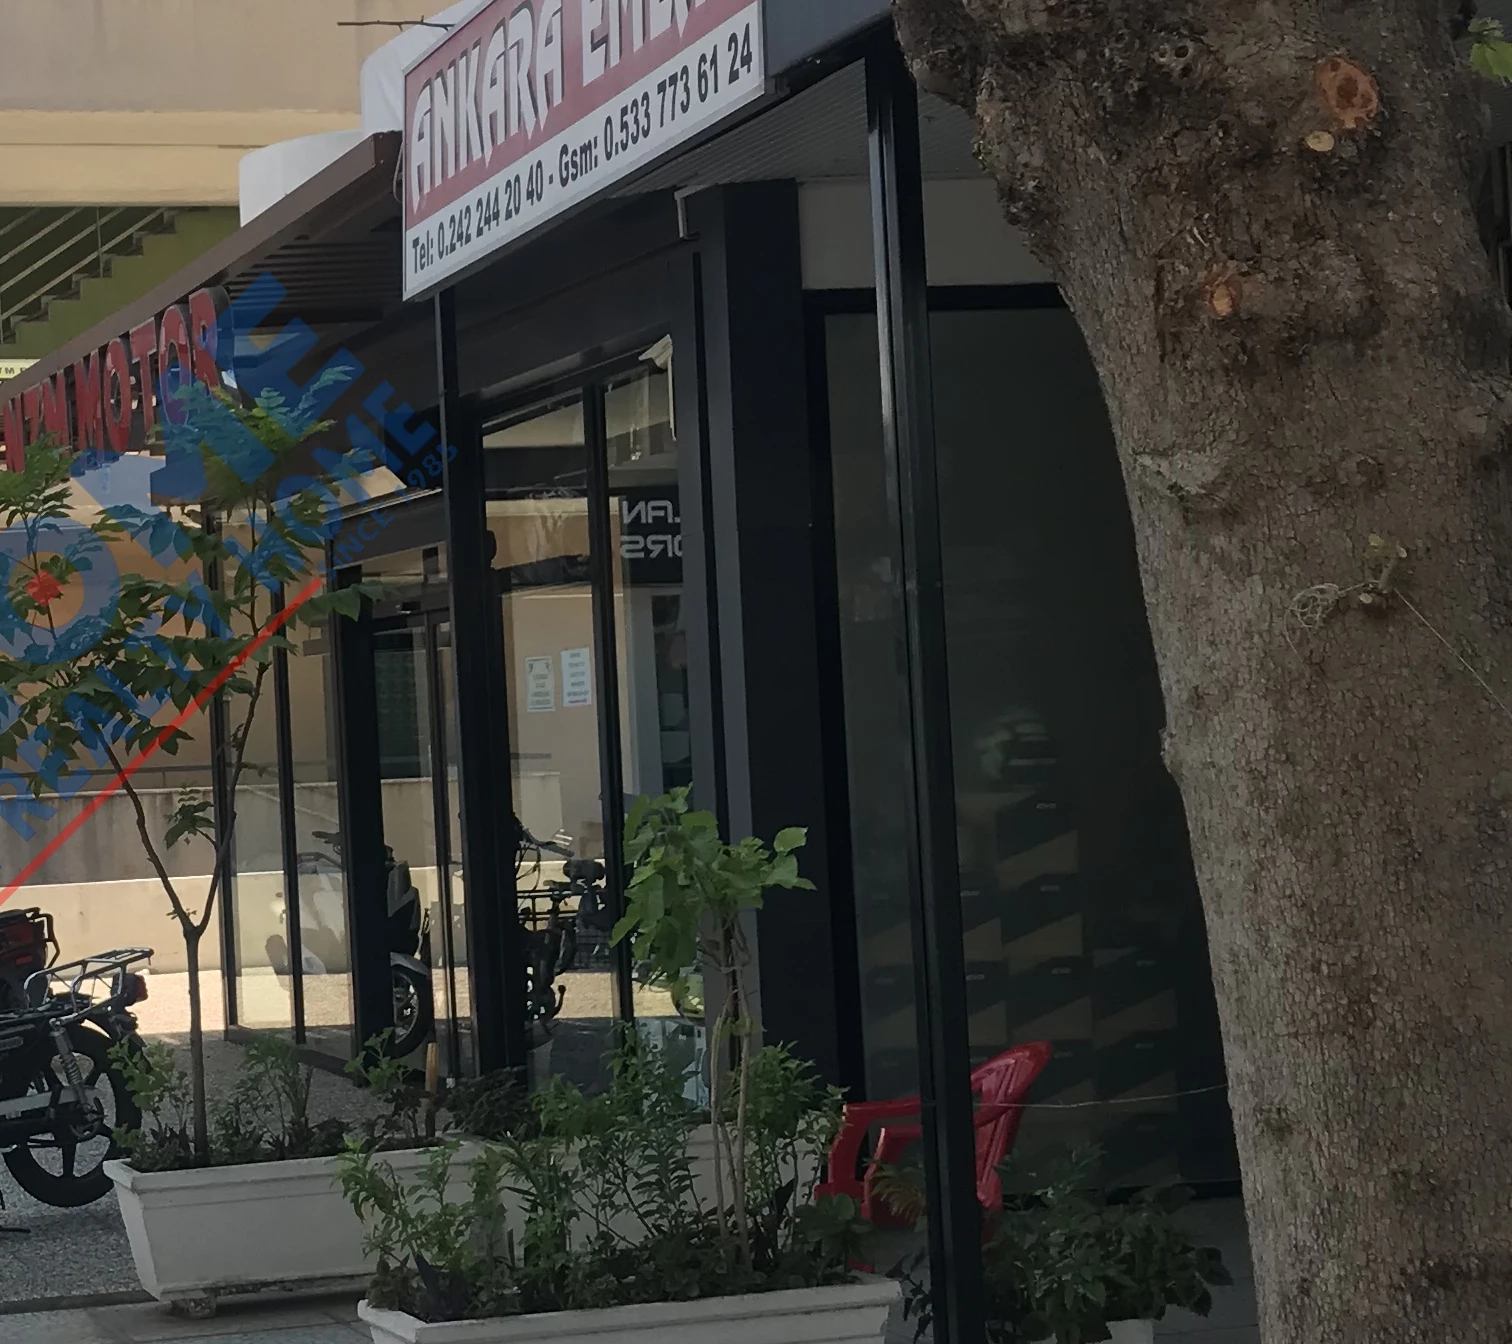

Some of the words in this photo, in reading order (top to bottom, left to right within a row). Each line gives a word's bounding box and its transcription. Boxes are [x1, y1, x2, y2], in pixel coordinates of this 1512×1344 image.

[412, 231, 434, 274] Tel:
[437, 205, 472, 260] 0.242
[475, 188, 501, 239] 244
[504, 173, 522, 221] 20
[526, 159, 544, 203] 40
[558, 136, 598, 188] Gsm:
[603, 91, 651, 162] 0.533
[656, 64, 689, 128] 773
[697, 44, 719, 103] 61
[727, 23, 753, 85] 24
[74, 286, 236, 462] MOTOR
